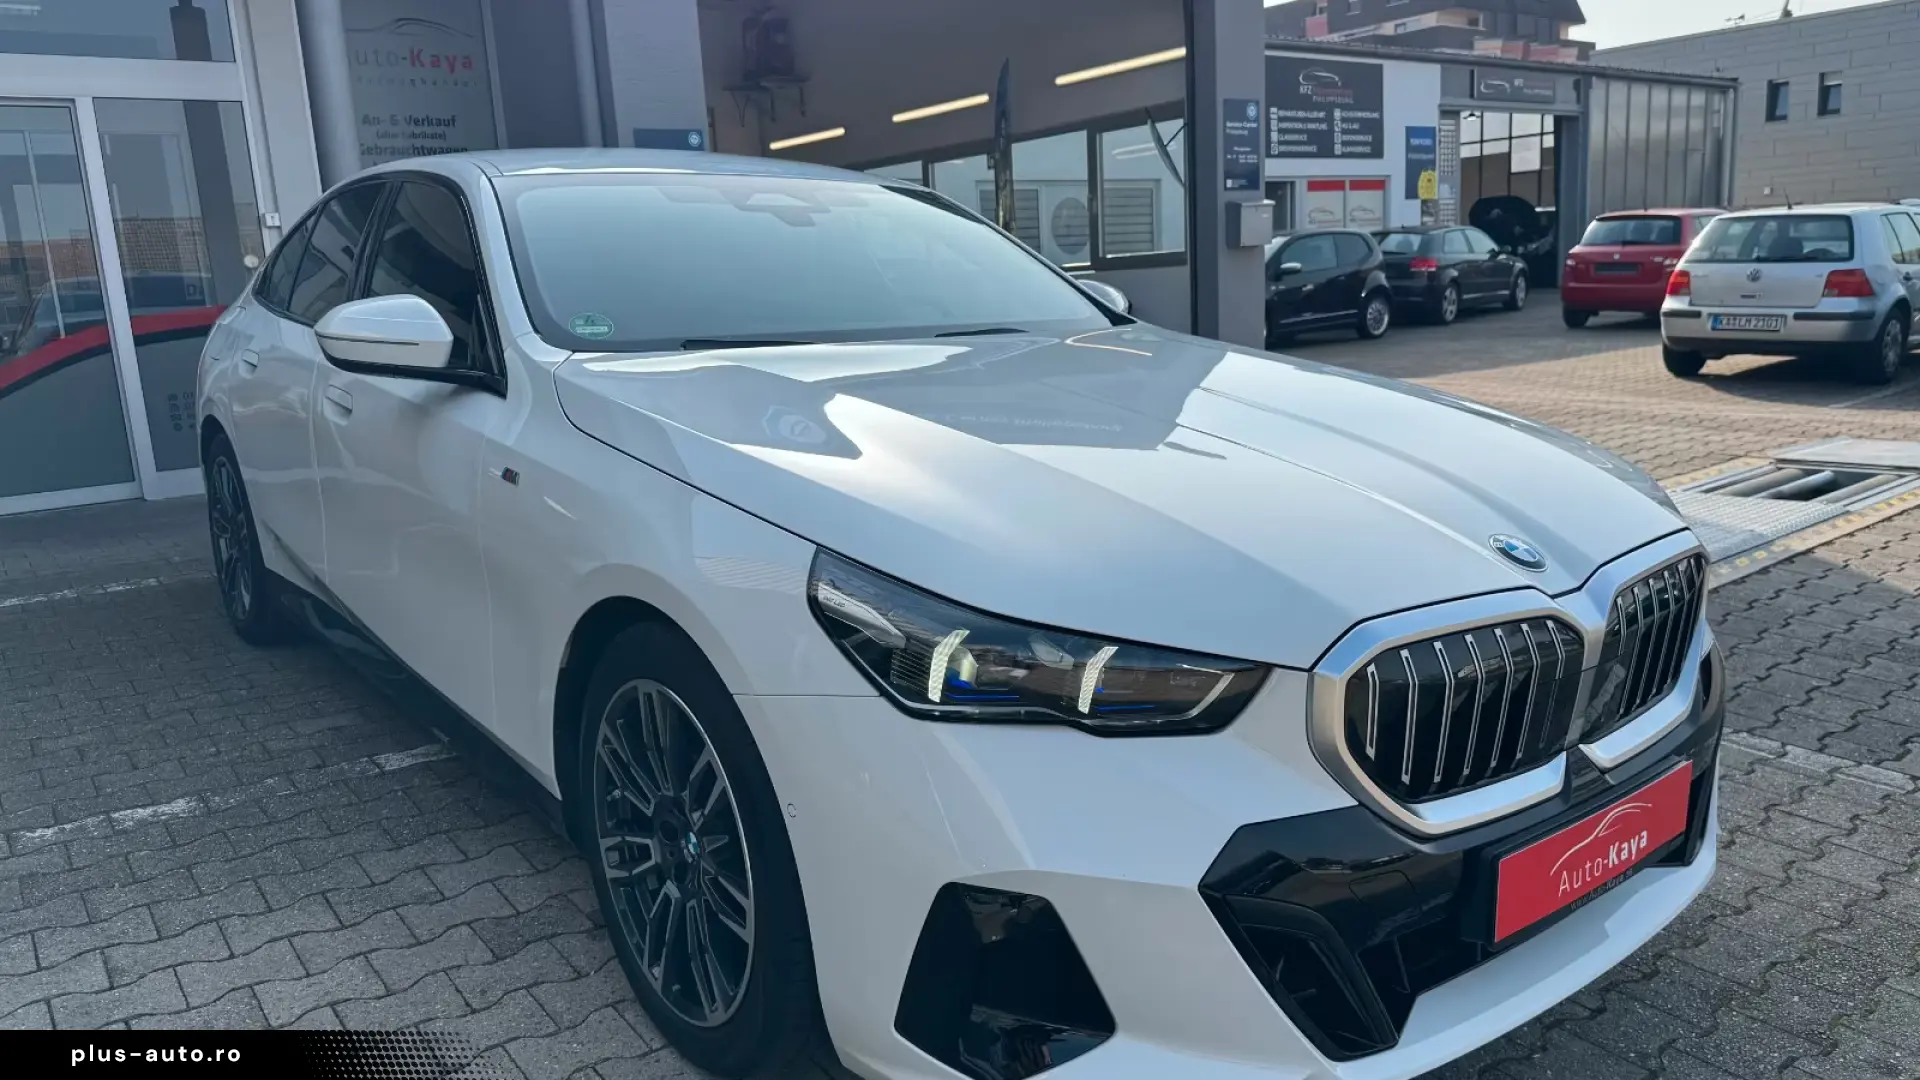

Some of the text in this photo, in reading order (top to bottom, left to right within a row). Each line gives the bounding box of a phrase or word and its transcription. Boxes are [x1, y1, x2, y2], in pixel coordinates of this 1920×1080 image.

[348, 46, 473, 74] uto-Kaya
[1299, 85, 1312, 94] KFZ
[404, 114, 457, 128] Verkauf
[1558, 829, 1648, 897] Auto-Kaya
